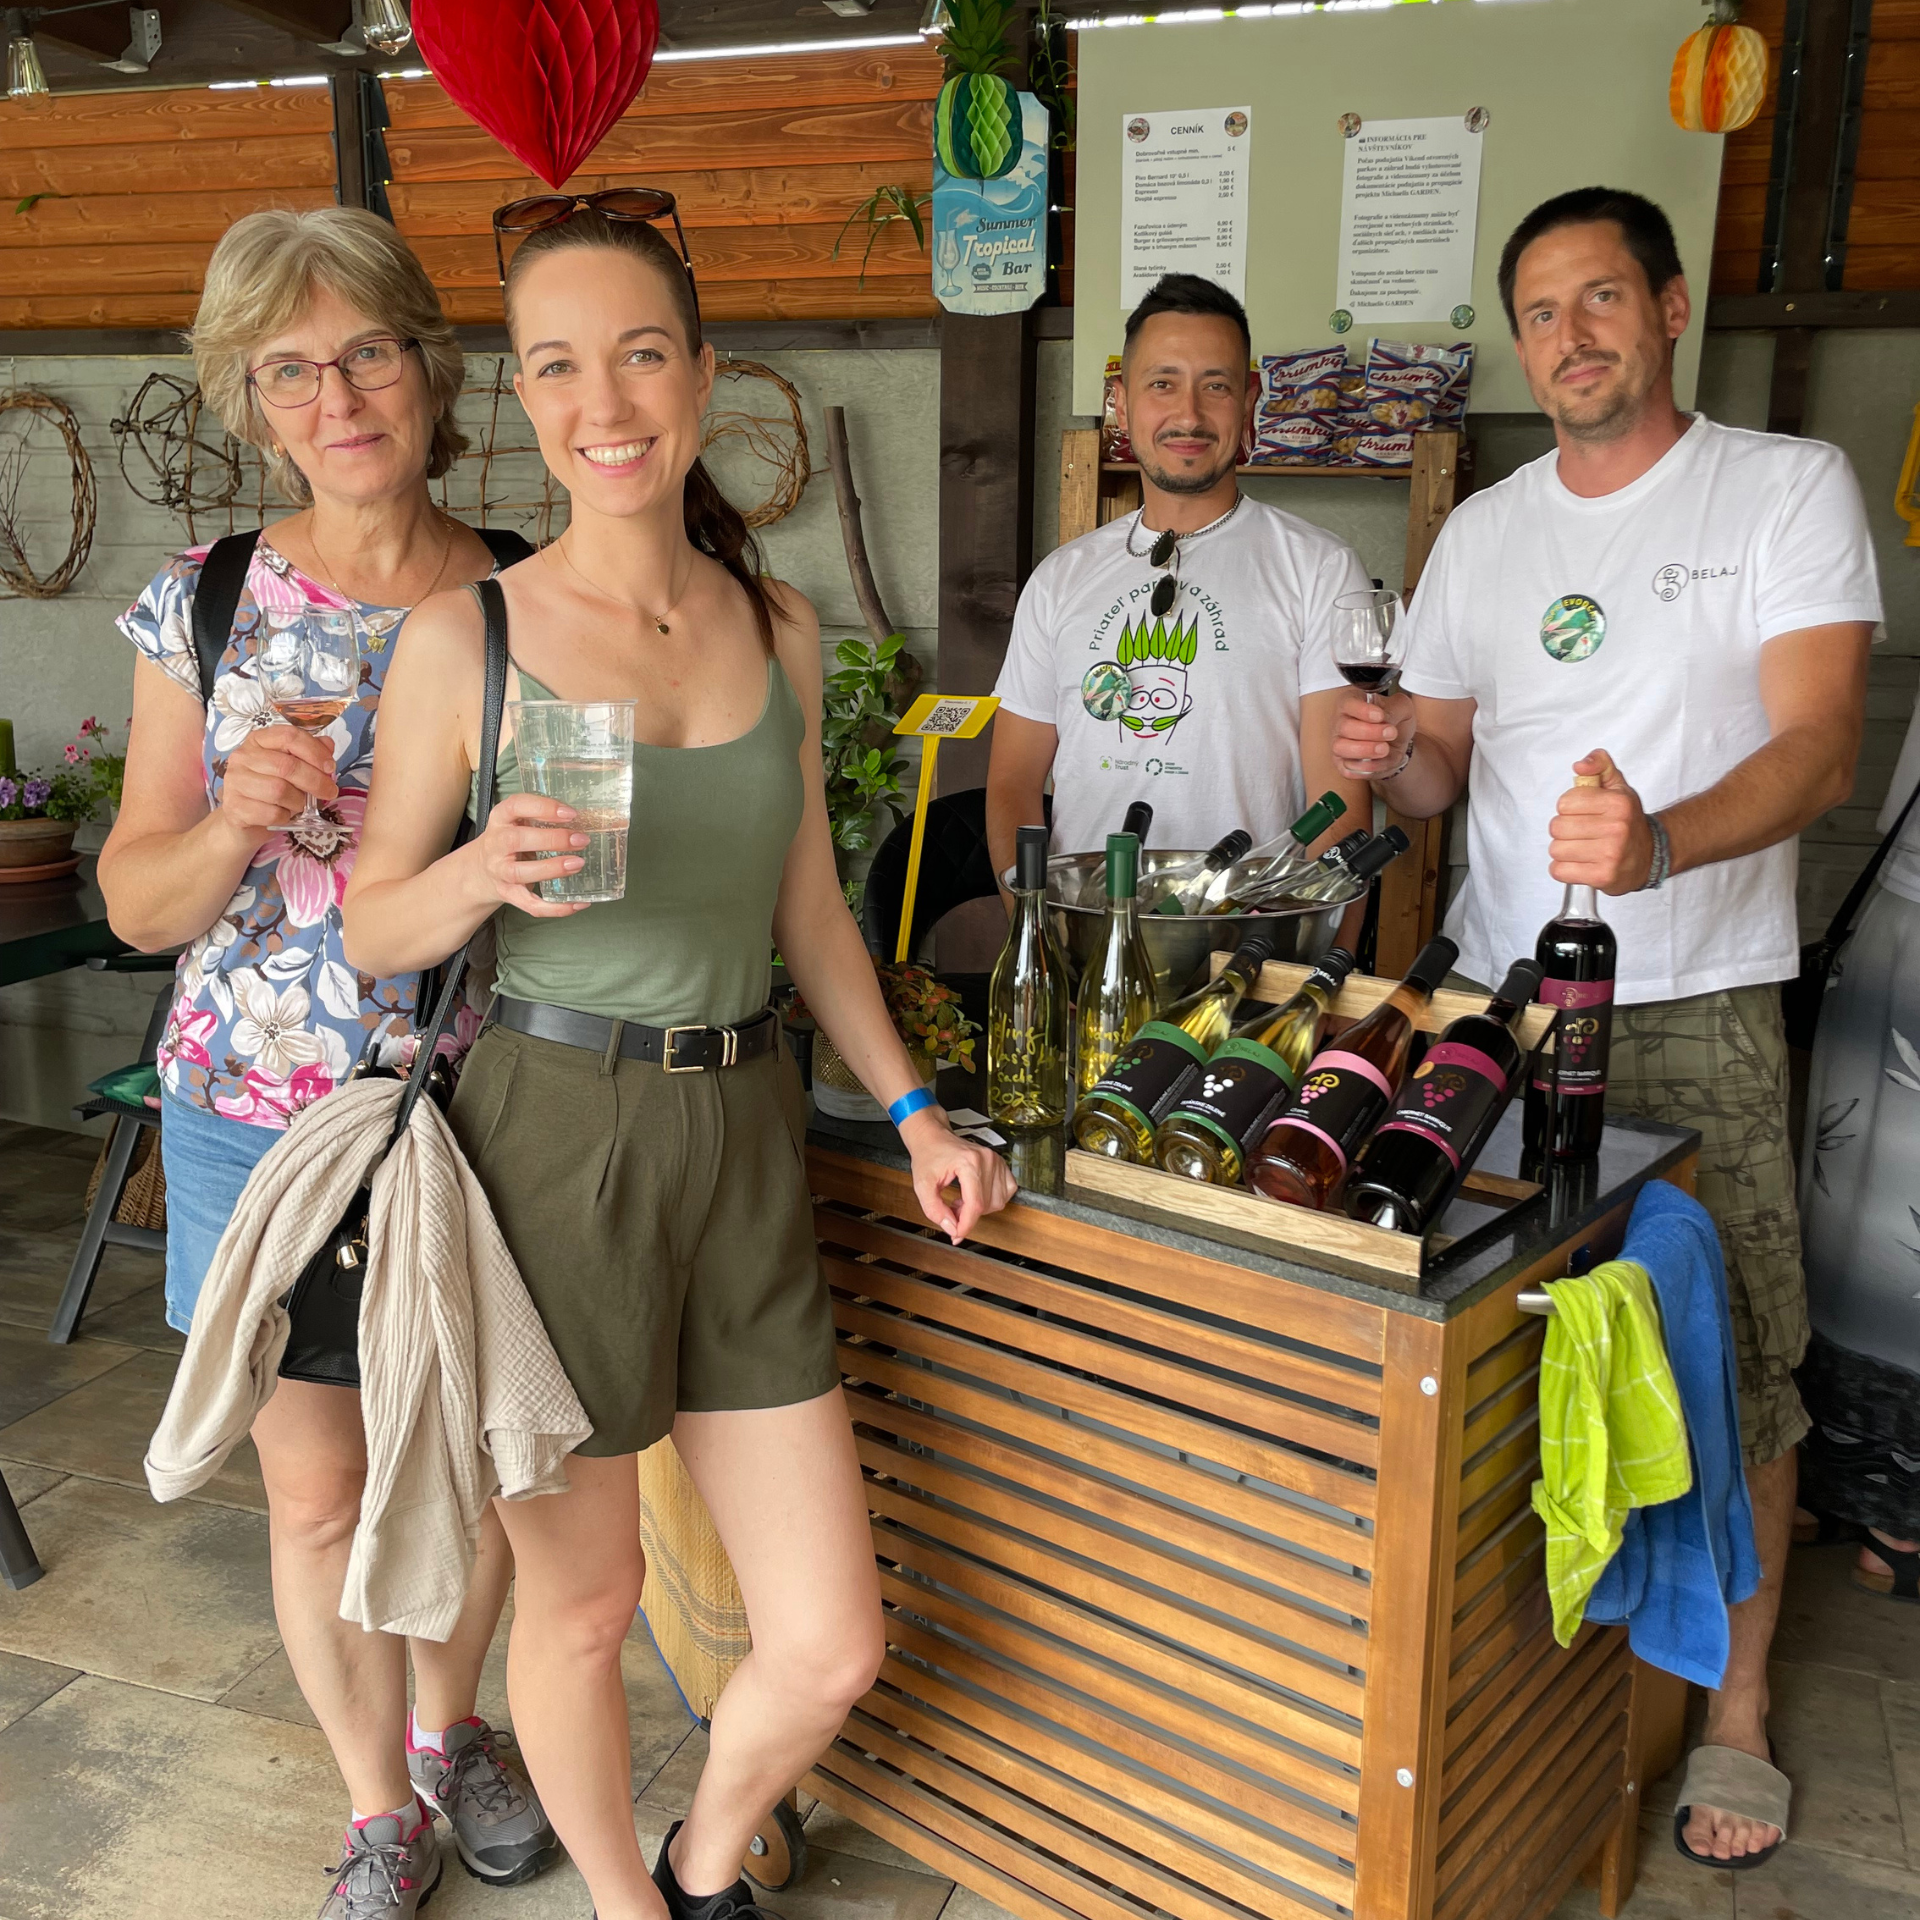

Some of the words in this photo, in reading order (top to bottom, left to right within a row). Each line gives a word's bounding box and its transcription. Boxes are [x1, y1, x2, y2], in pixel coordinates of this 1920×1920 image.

[1170, 123, 1204, 135] CENNÍK
[1367, 134, 1412, 142] INFORMÁCIA
[1358, 144, 1412, 152] NÁVŠTEVNÍKOV
[976, 216, 1036, 234] Summer
[962, 229, 1036, 267] Tropical
[1002, 261, 1032, 276] Bar
[1691, 565, 1738, 580] BELAJ
[1089, 596, 1125, 650] Priateľ
[1129, 579, 1189, 602] parv
[1190, 586, 1201, 597] a
[1200, 594, 1230, 651] záhrad
